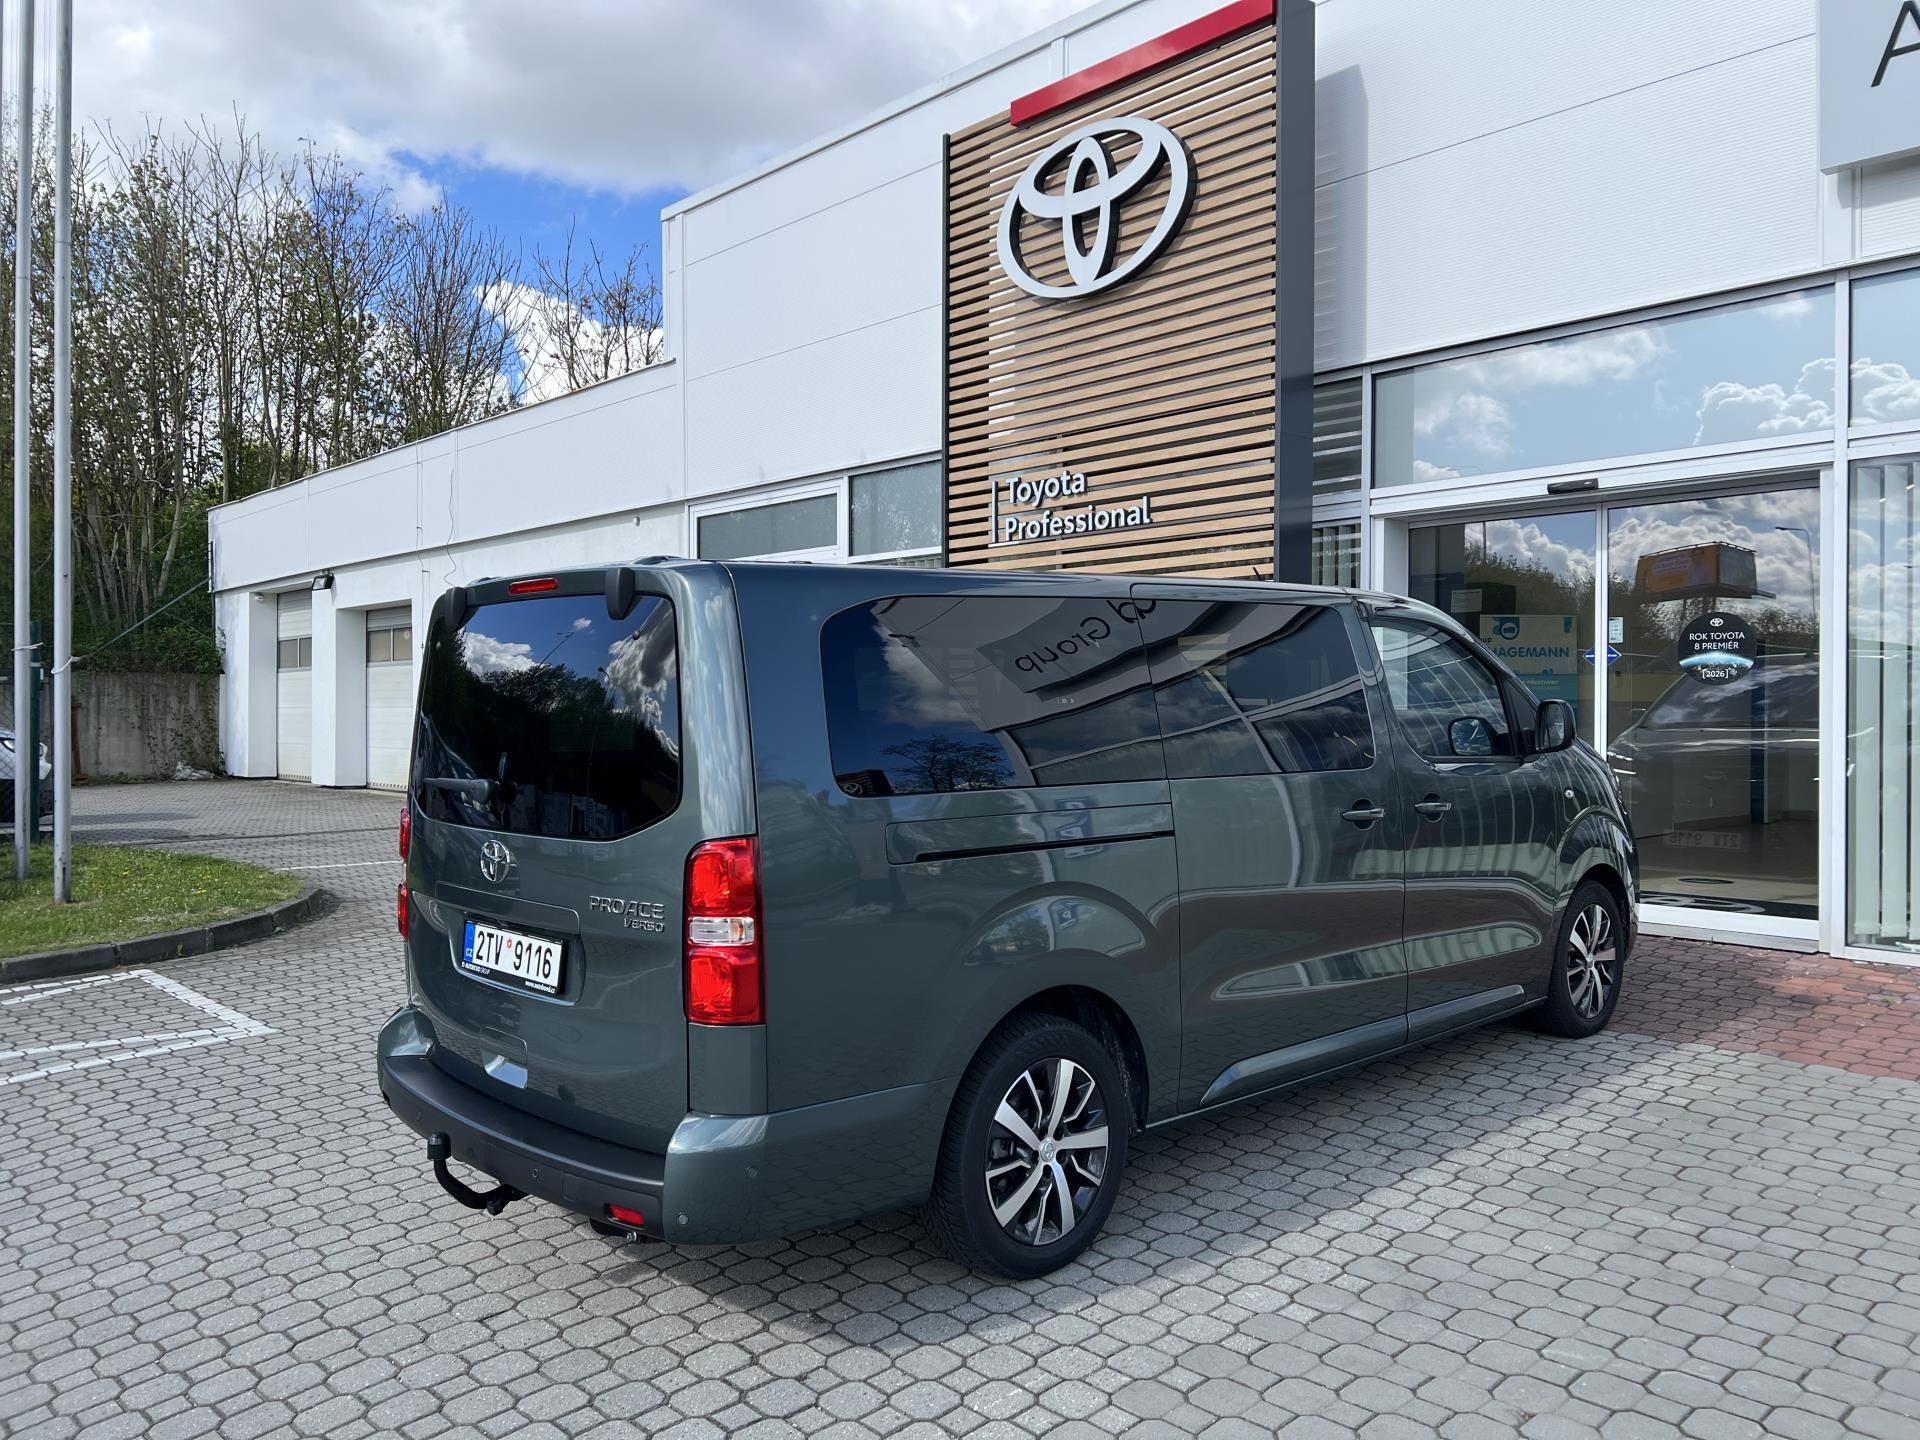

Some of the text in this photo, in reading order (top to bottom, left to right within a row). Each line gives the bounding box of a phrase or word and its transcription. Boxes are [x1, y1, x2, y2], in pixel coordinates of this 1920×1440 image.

[1005, 470, 1087, 508] Toyota
[1004, 495, 1152, 542] Professional
[1689, 631, 1745, 640] ROK TOYOTA
[1694, 640, 1739, 650] 8 PREMIÉR
[589, 895, 665, 920] PROACE
[623, 917, 666, 933] VERSO
[466, 947, 473, 957] CZ
[476, 930, 553, 979] 2TV 9116
